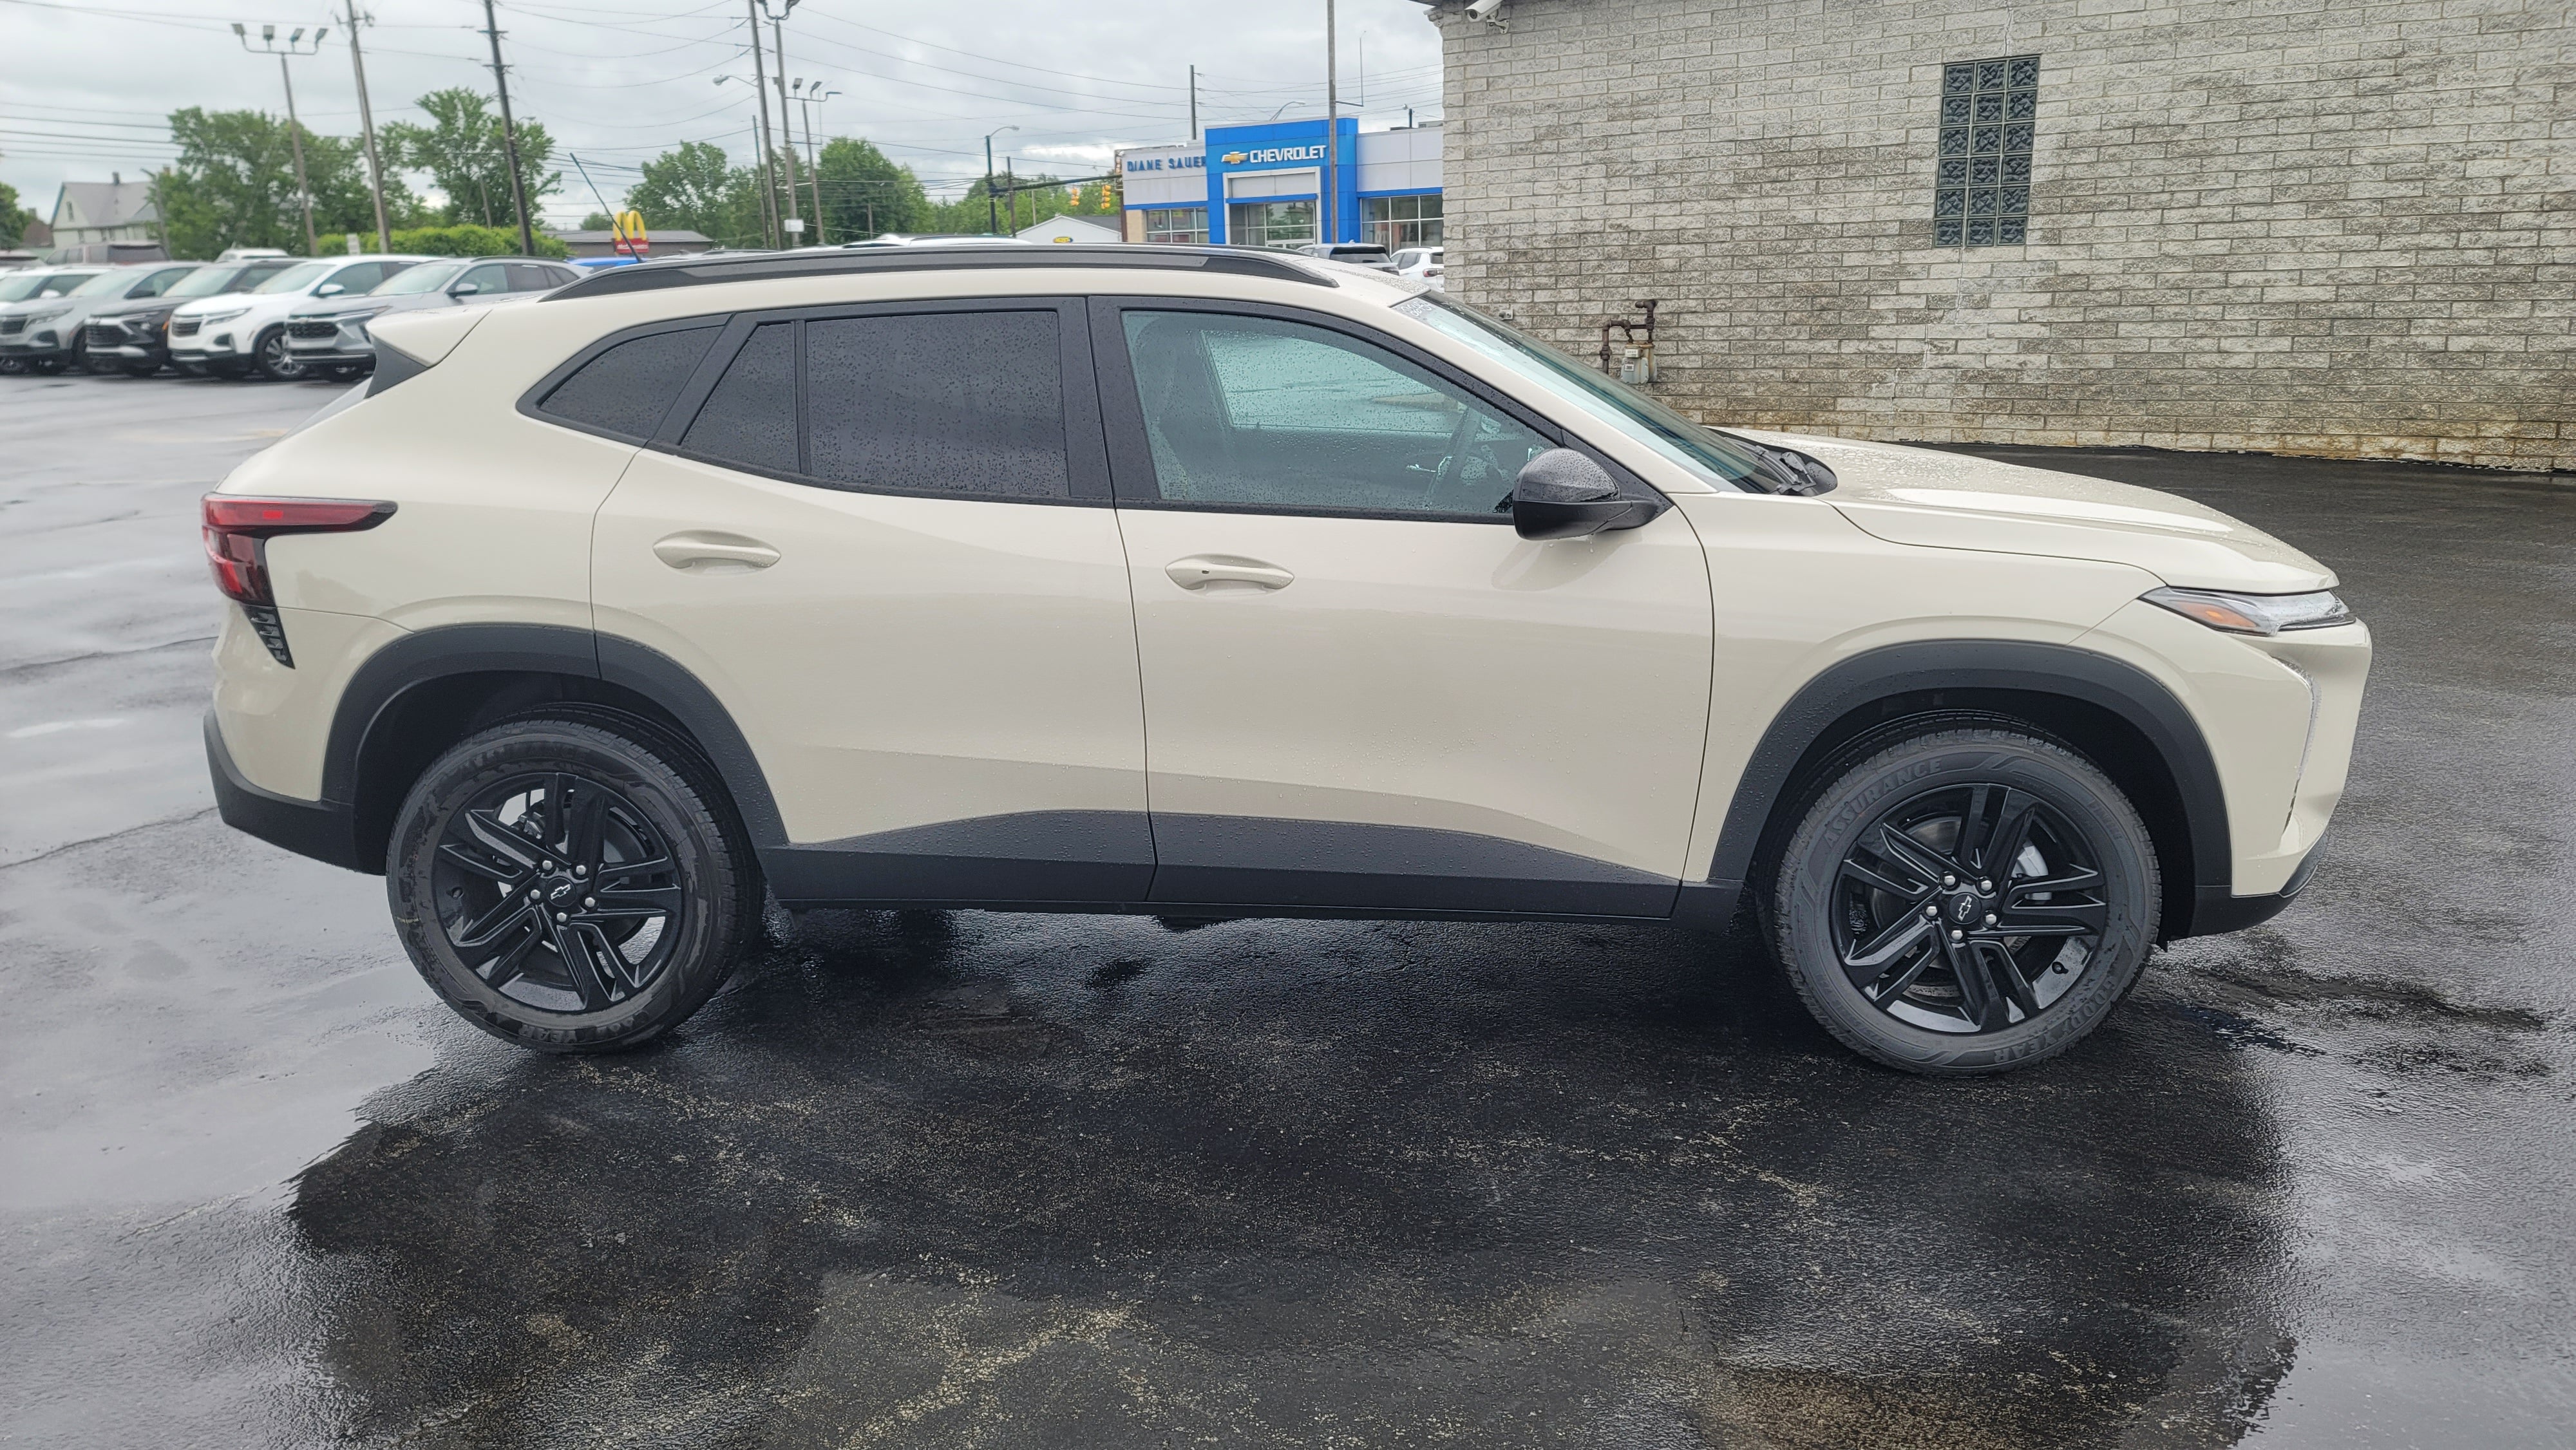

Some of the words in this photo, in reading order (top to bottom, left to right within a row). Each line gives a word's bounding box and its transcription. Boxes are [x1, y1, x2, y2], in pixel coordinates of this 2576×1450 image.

[1249, 145, 1327, 164] CHEVROLET
[1127, 159, 1162, 172] DIANE
[1824, 758, 1942, 848] ASSURANCE
